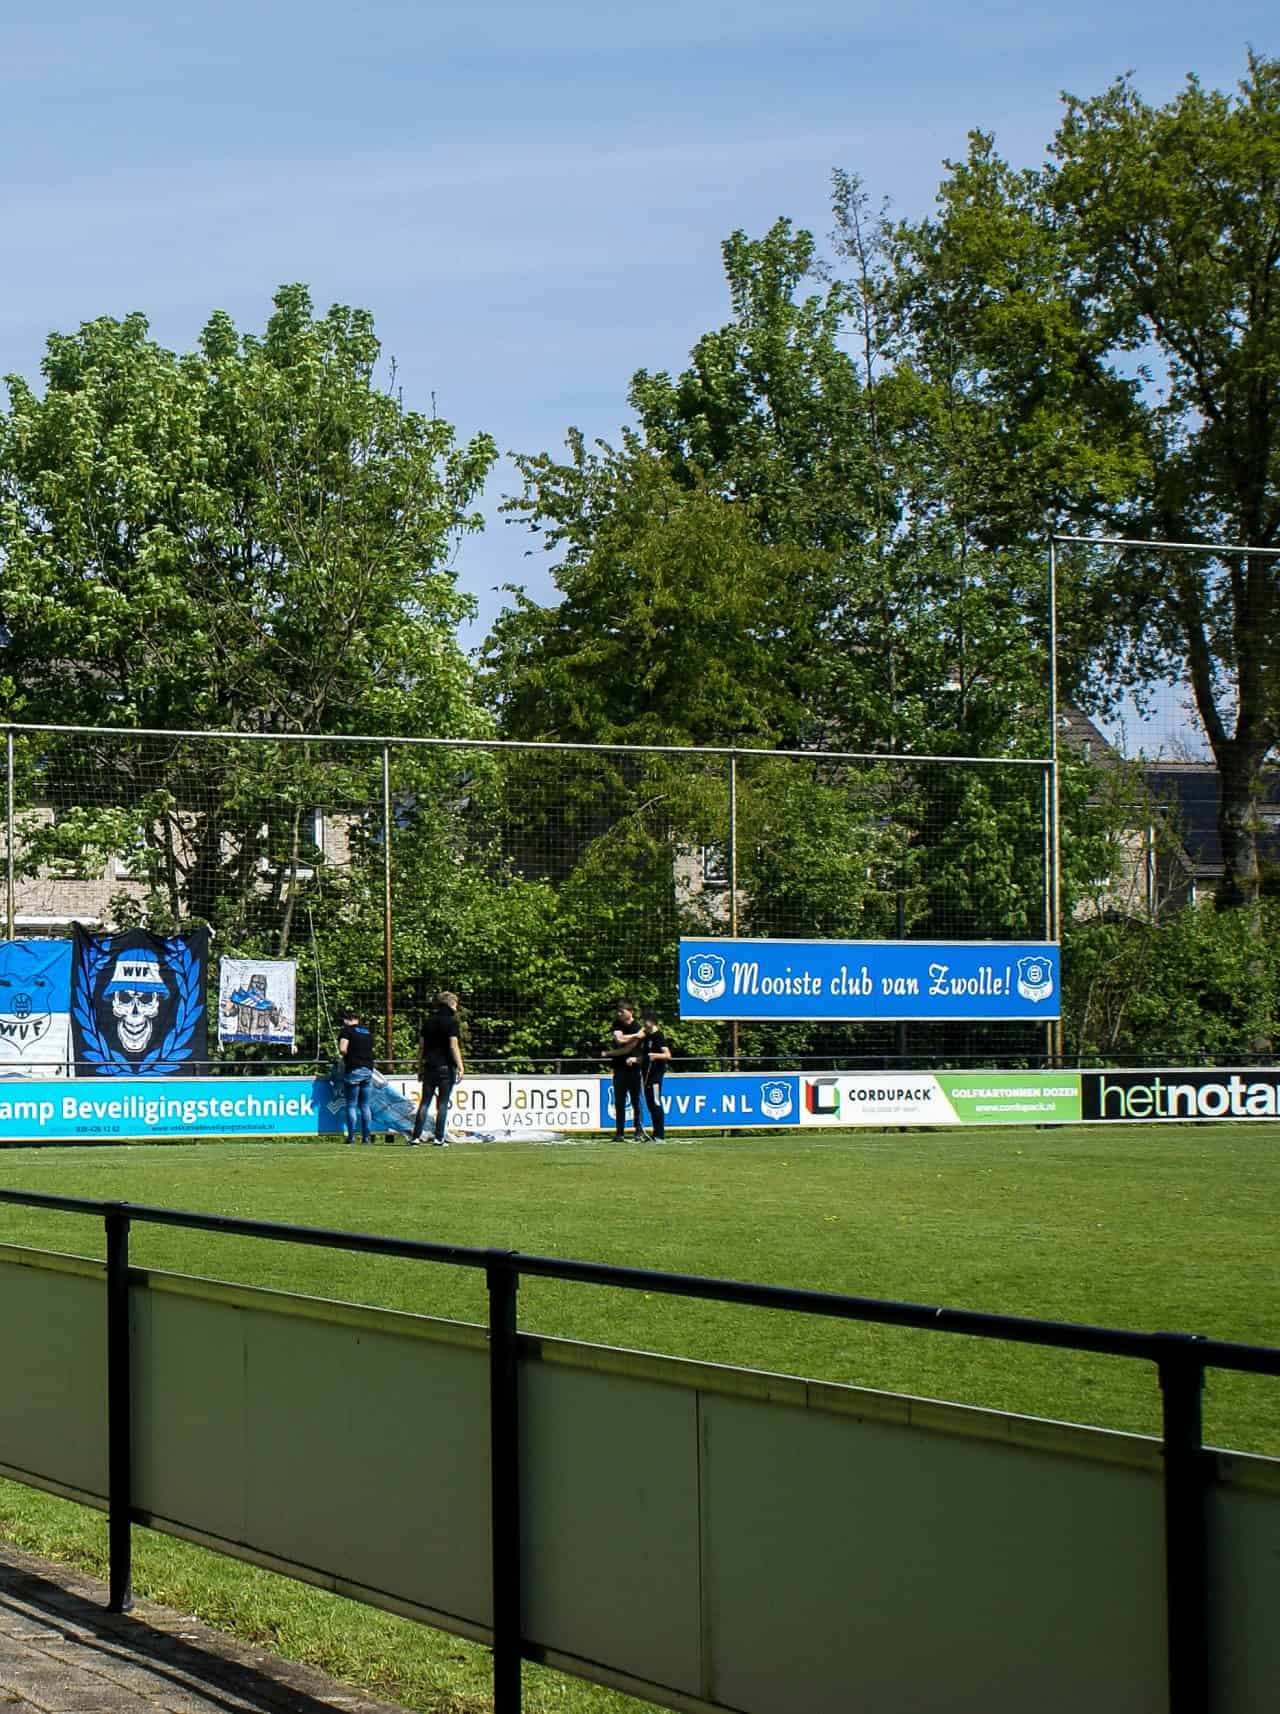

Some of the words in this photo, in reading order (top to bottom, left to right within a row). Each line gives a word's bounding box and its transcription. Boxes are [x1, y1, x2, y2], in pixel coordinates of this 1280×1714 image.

[122, 966, 150, 977] WVF
[731, 962, 821, 996] Mooiste
[830, 965, 873, 996] club
[881, 977, 919, 996] van
[928, 963, 1011, 996] Zwolle!
[0, 1020, 43, 1041] WVF
[402, 1083, 486, 1111] asen
[503, 1081, 590, 1110] Jansen
[848, 1088, 931, 1101] CORDUPACK
[1043, 1087, 1079, 1097] DOZEN
[1100, 1075, 1280, 1117] hetnota
[62, 1094, 315, 1125] Beveiligingstechniek
[503, 1111, 590, 1127] VASTGOED
